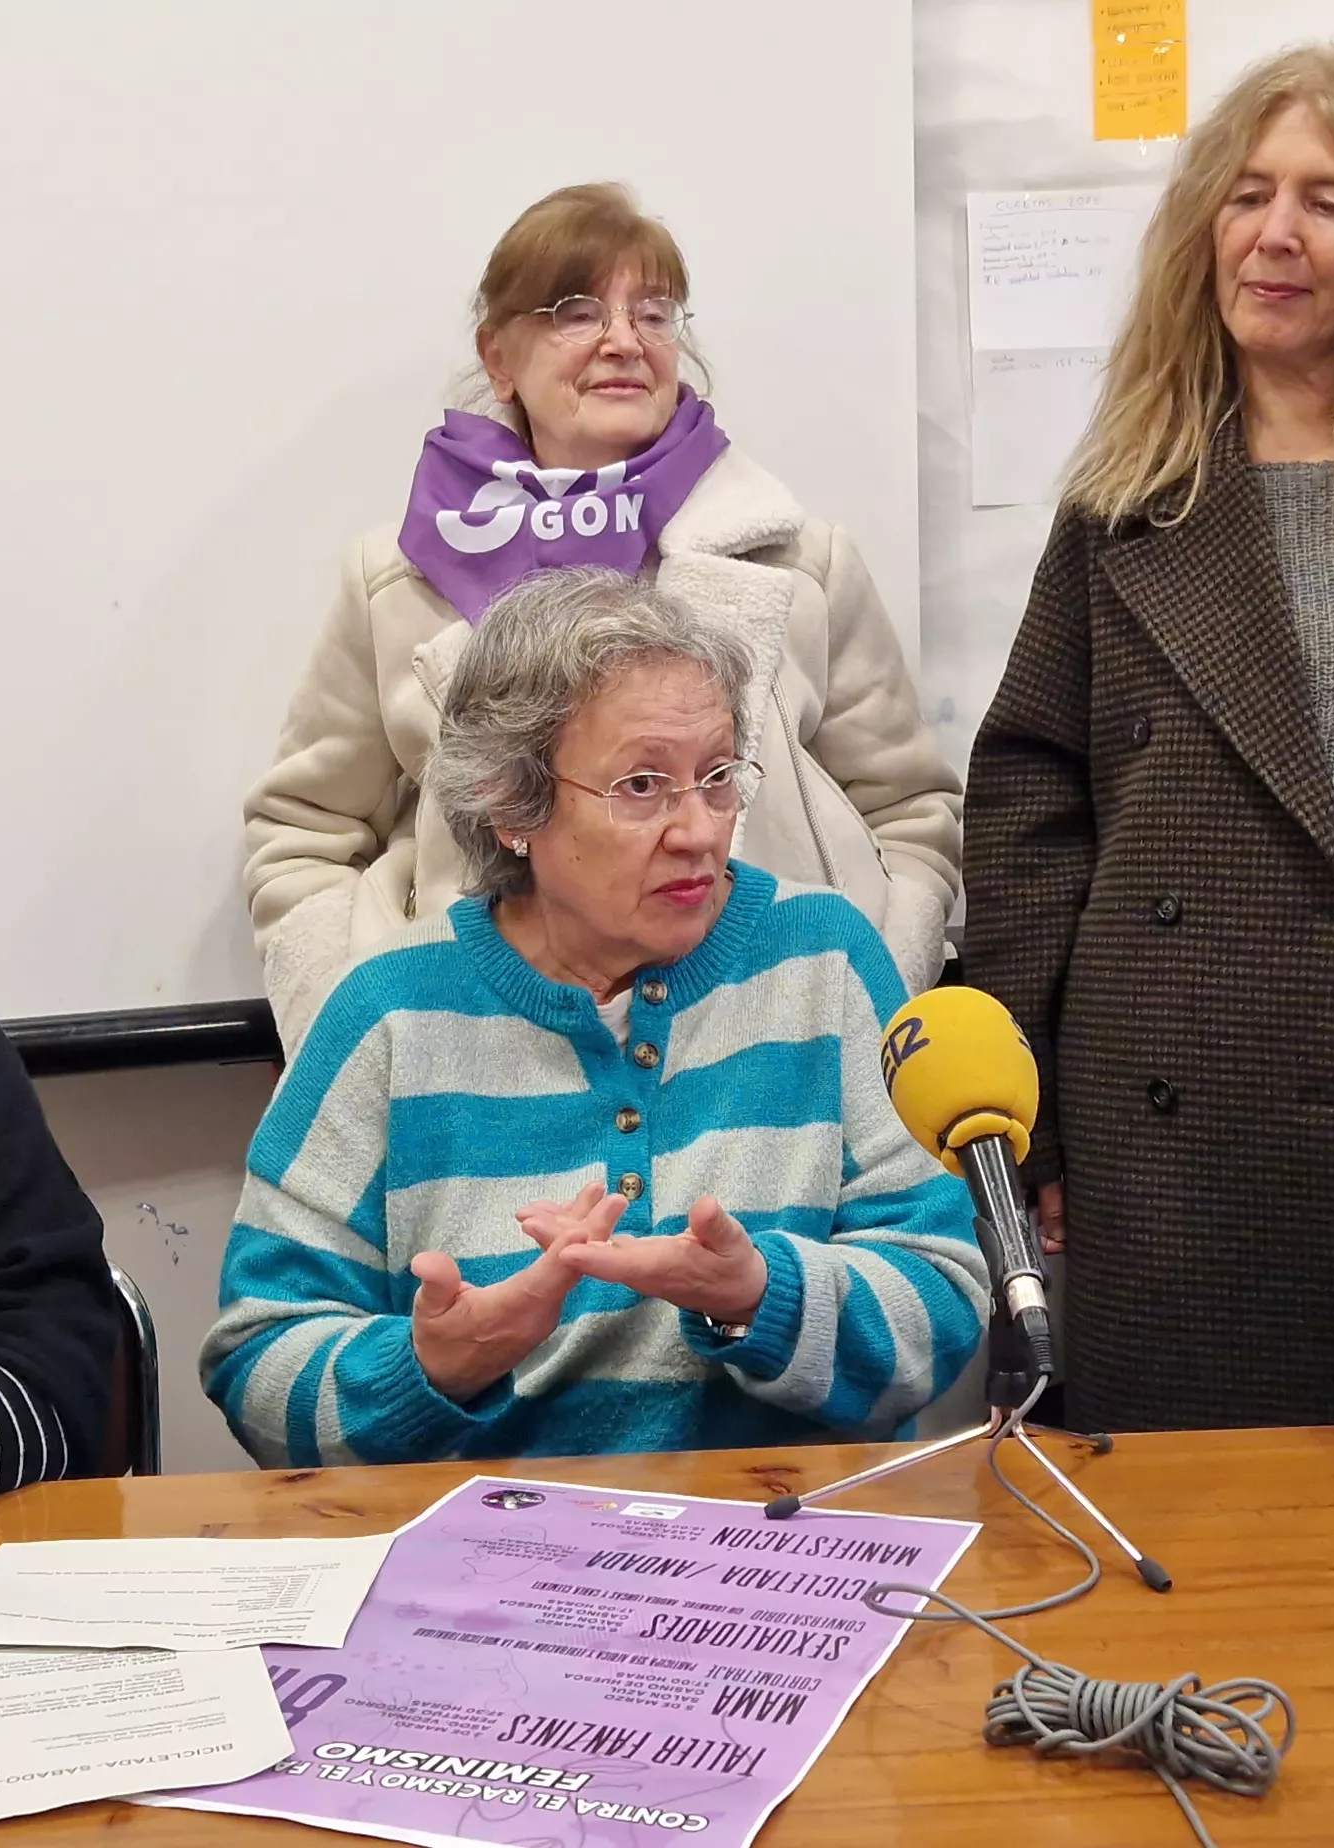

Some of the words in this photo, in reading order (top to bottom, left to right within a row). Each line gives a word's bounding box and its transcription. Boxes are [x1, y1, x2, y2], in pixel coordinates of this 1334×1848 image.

[709, 1526, 922, 1567] MANIFESTACIÓN
[639, 1613, 851, 1661] SEXUALIDADES
[750, 1609, 867, 1634] CONVERSATORIO
[704, 1664, 822, 1692] CORTOMETRAJE
[603, 1694, 658, 1706] MARZO
[711, 1685, 808, 1725] MAMA
[497, 1713, 652, 1760] FANZINES
[96, 1742, 234, 1769] BICICLETADA-
[313, 1742, 594, 1792] FEMINISMO
[317, 1763, 352, 1781] EL
[651, 1734, 767, 1777] TALLER
[349, 1769, 374, 1788] Y
[379, 1772, 526, 1805] RACISMO
[533, 1792, 568, 1811] EL
[574, 1797, 710, 1833] CONTRA
